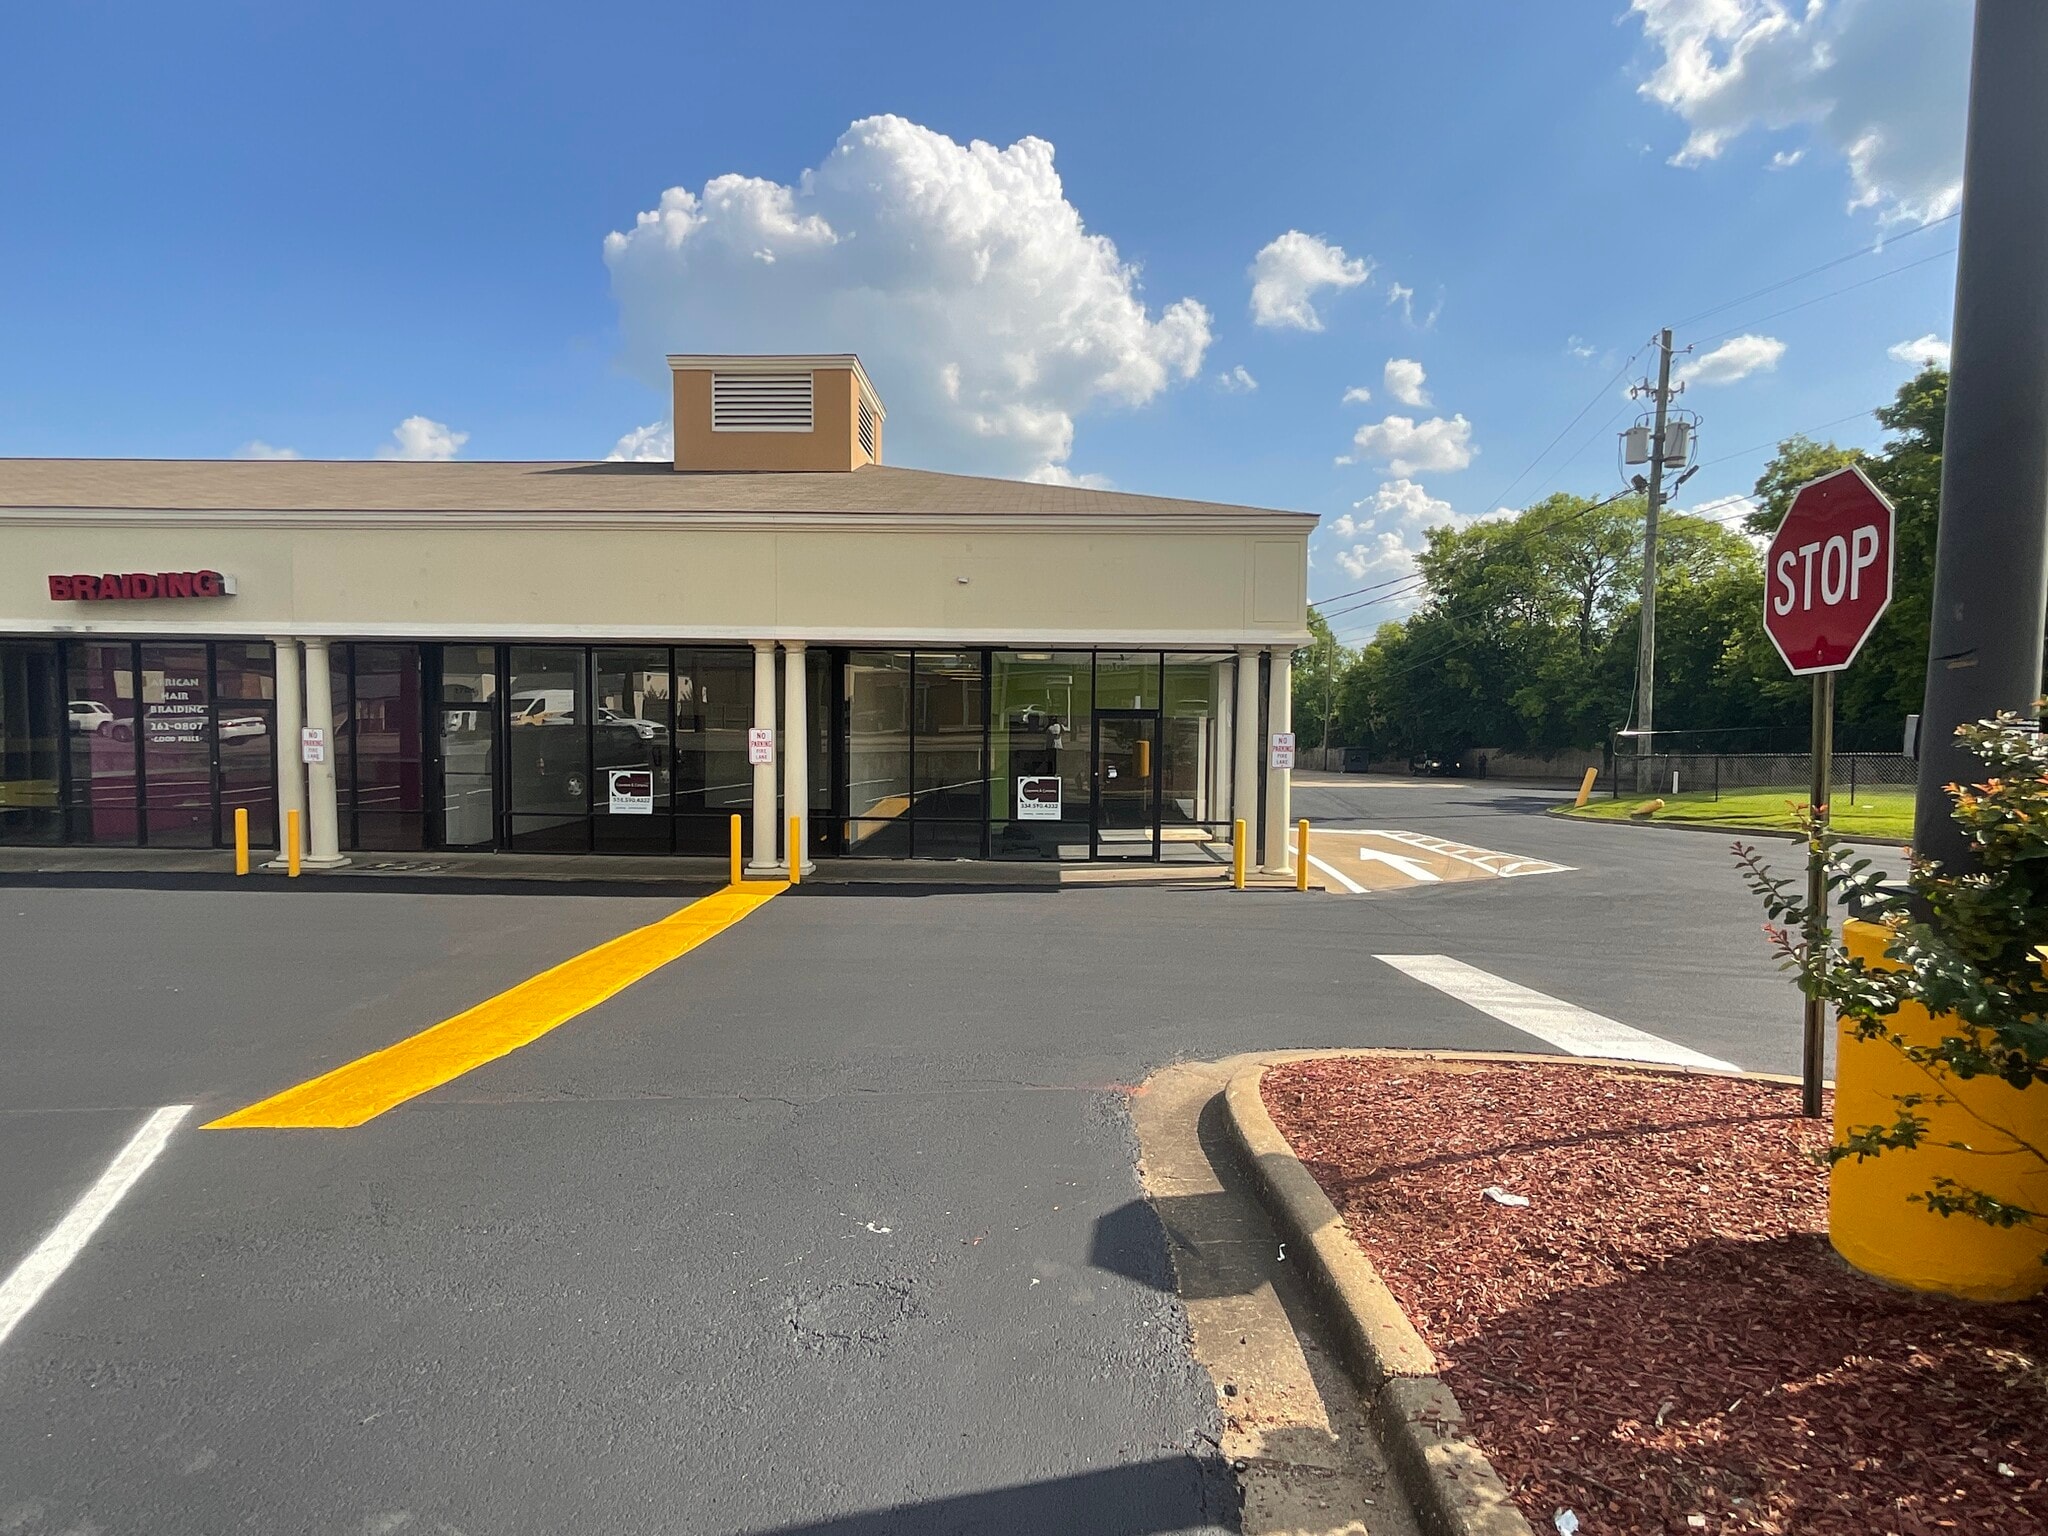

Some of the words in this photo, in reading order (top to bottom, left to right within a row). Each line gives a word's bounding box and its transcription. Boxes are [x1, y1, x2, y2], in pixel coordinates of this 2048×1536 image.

[1774, 525, 1879, 617] STOP
[48, 570, 222, 601] BRAIDING
[160, 692, 189, 700] HAIR
[150, 705, 204, 713] BRAIDING
[308, 731, 319, 739] NO
[756, 732, 767, 740] NO
